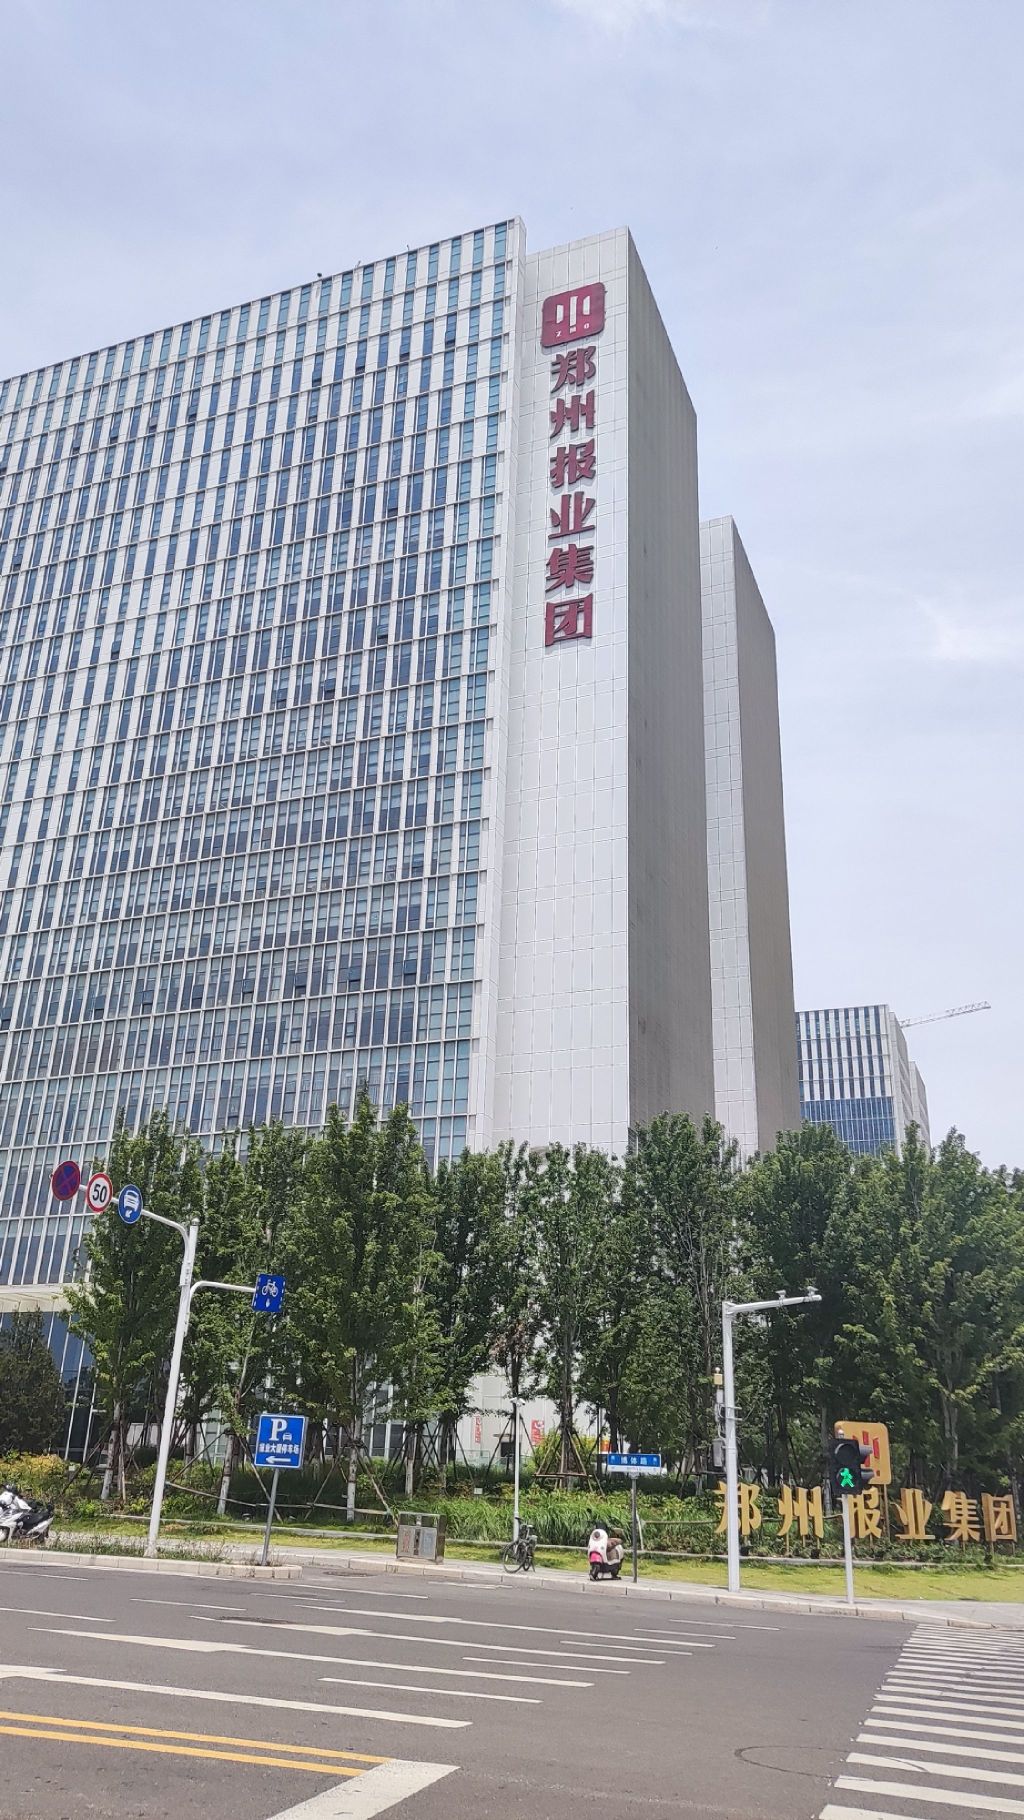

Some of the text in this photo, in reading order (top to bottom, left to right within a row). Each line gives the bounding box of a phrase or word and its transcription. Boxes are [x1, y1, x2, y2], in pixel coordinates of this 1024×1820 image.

[544, 345, 597, 648] 郑州报业集团
[92, 1183, 107, 1203] 50
[269, 1418, 287, 1441] P
